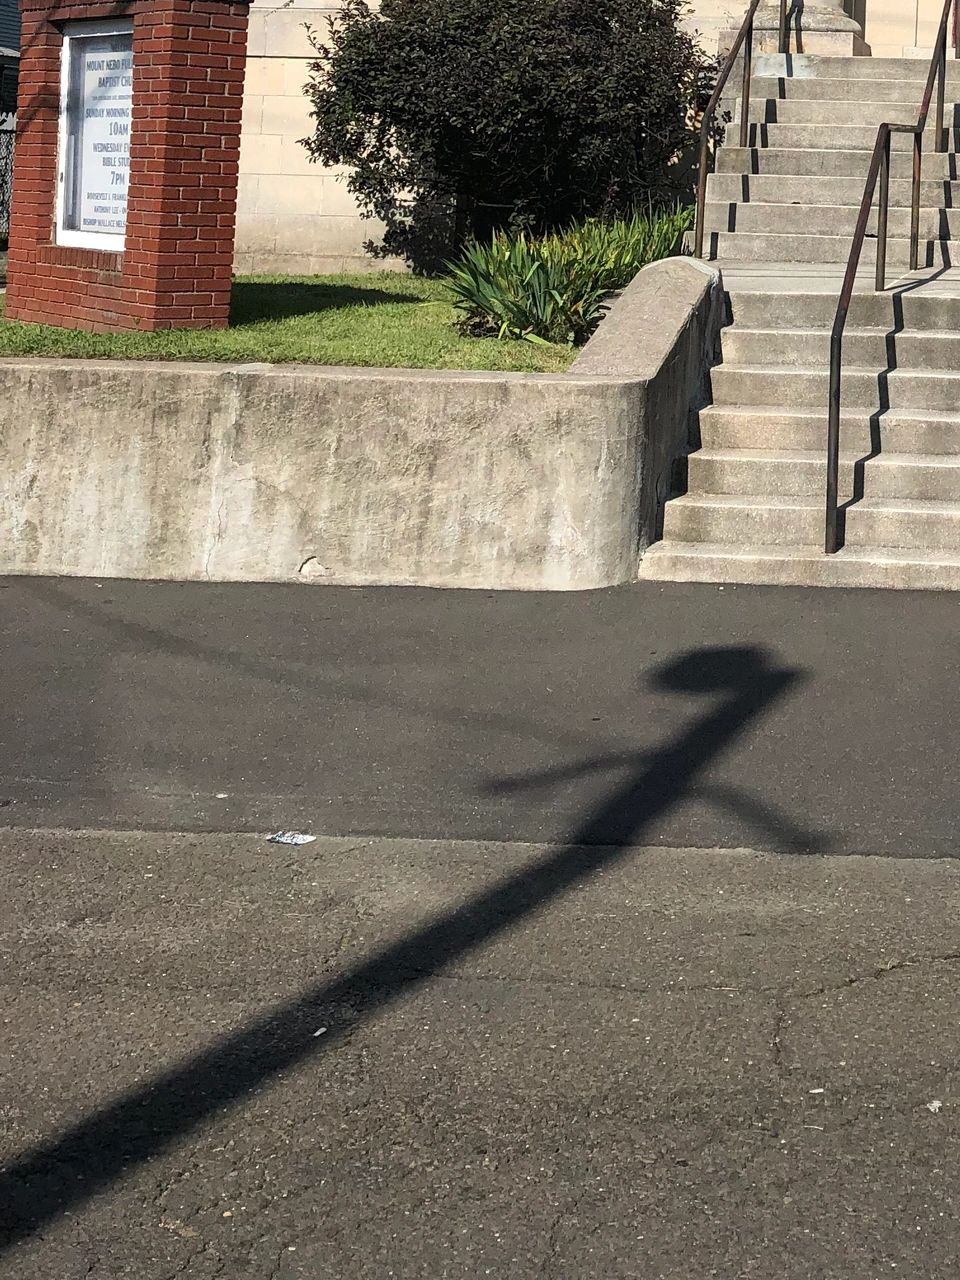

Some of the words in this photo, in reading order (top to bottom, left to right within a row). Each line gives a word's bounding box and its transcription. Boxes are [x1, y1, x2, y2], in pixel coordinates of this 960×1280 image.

[86, 60, 105, 71] MOUNT
[106, 59, 121, 70] NEBO
[98, 76, 120, 88] BAPTIST
[85, 108, 104, 118] SUNDAY
[105, 107, 129, 118] MORNING
[109, 121, 129, 135] 10AM
[92, 142, 122, 152] WEDNESDAY
[102, 156, 117, 167] BIBLE
[111, 171, 125, 185] 7PM
